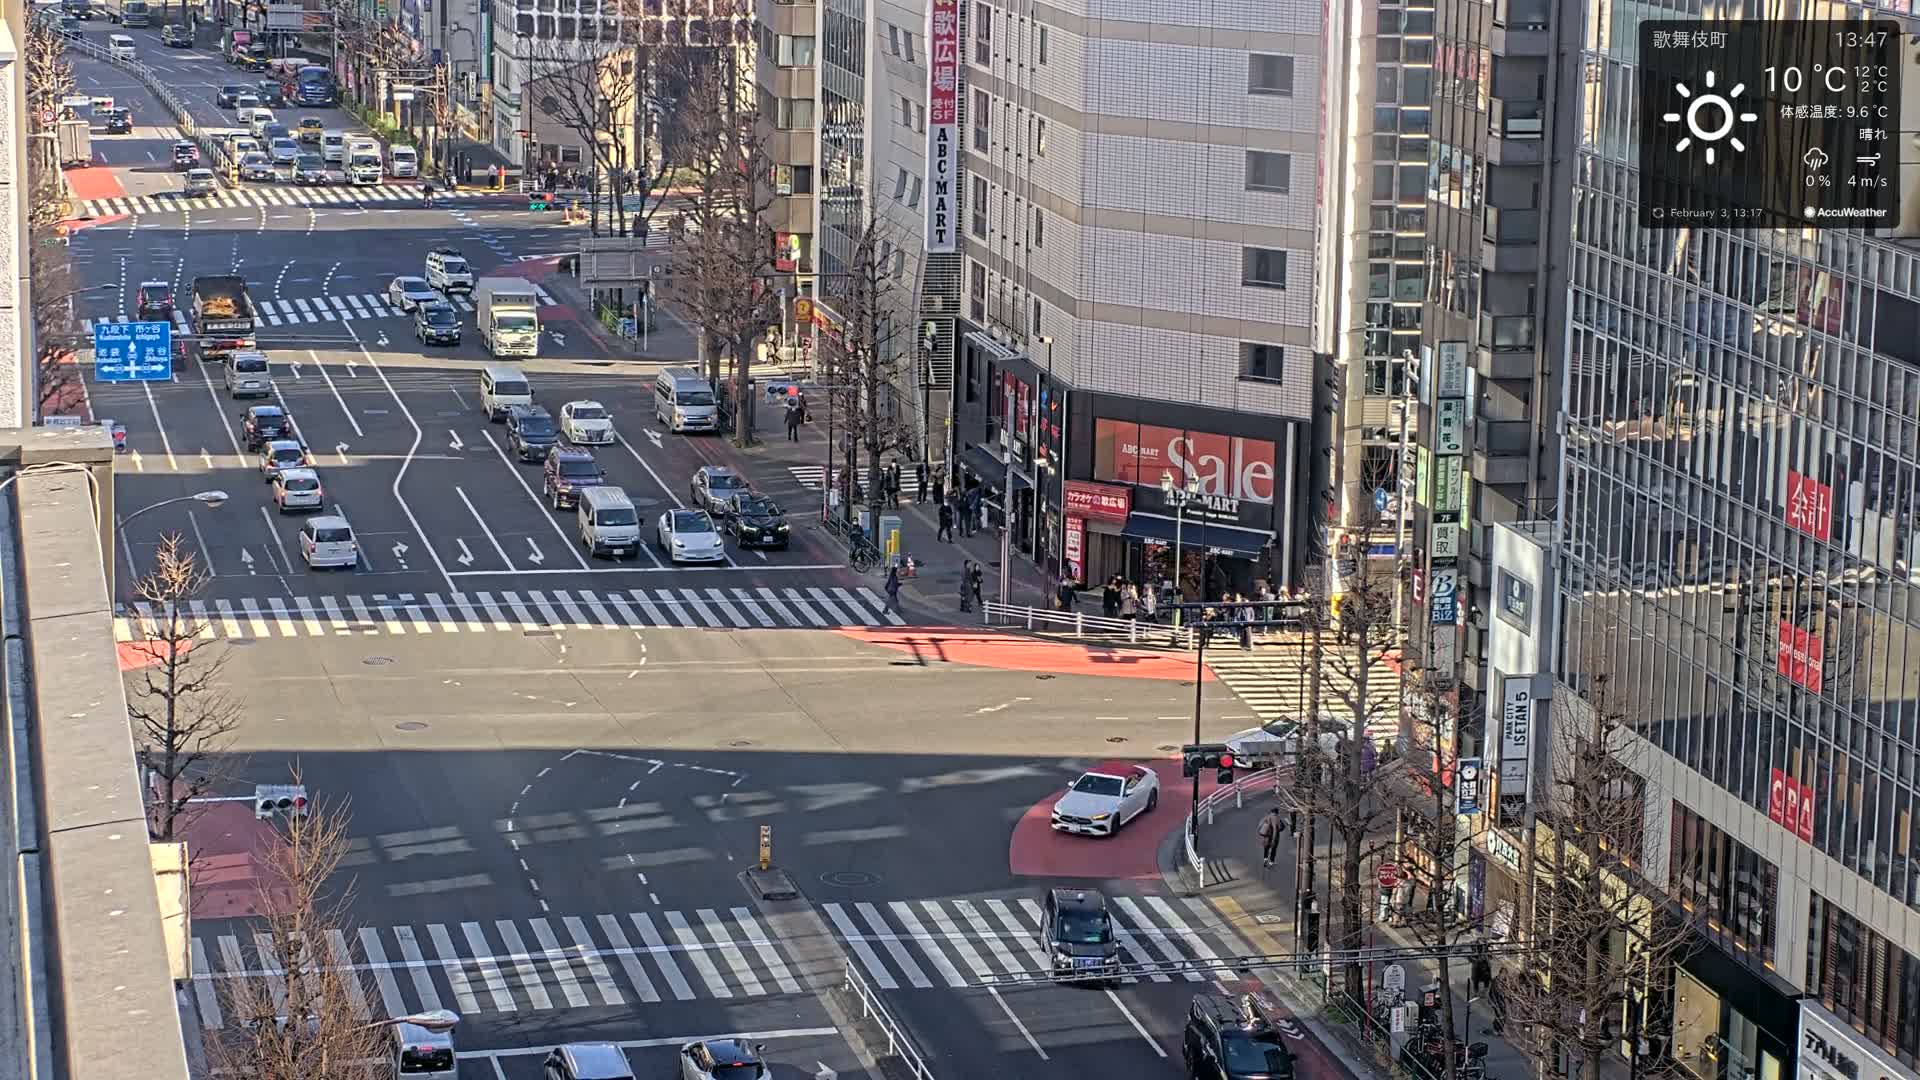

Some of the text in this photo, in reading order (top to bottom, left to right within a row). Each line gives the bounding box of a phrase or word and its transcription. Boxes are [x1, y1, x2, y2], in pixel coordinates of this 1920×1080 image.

[933, 10, 955, 91] 歌広場
[1167, 436, 1273, 504] Sale
[1441, 514, 1452, 522] 7F
[1791, 481, 1827, 531] 会計
[1436, 526, 1449, 554] 買取
[1505, 702, 1514, 740] PARK CITY
[1513, 691, 1528, 746] ISETAN 5
[1772, 780, 1811, 829] CPA
